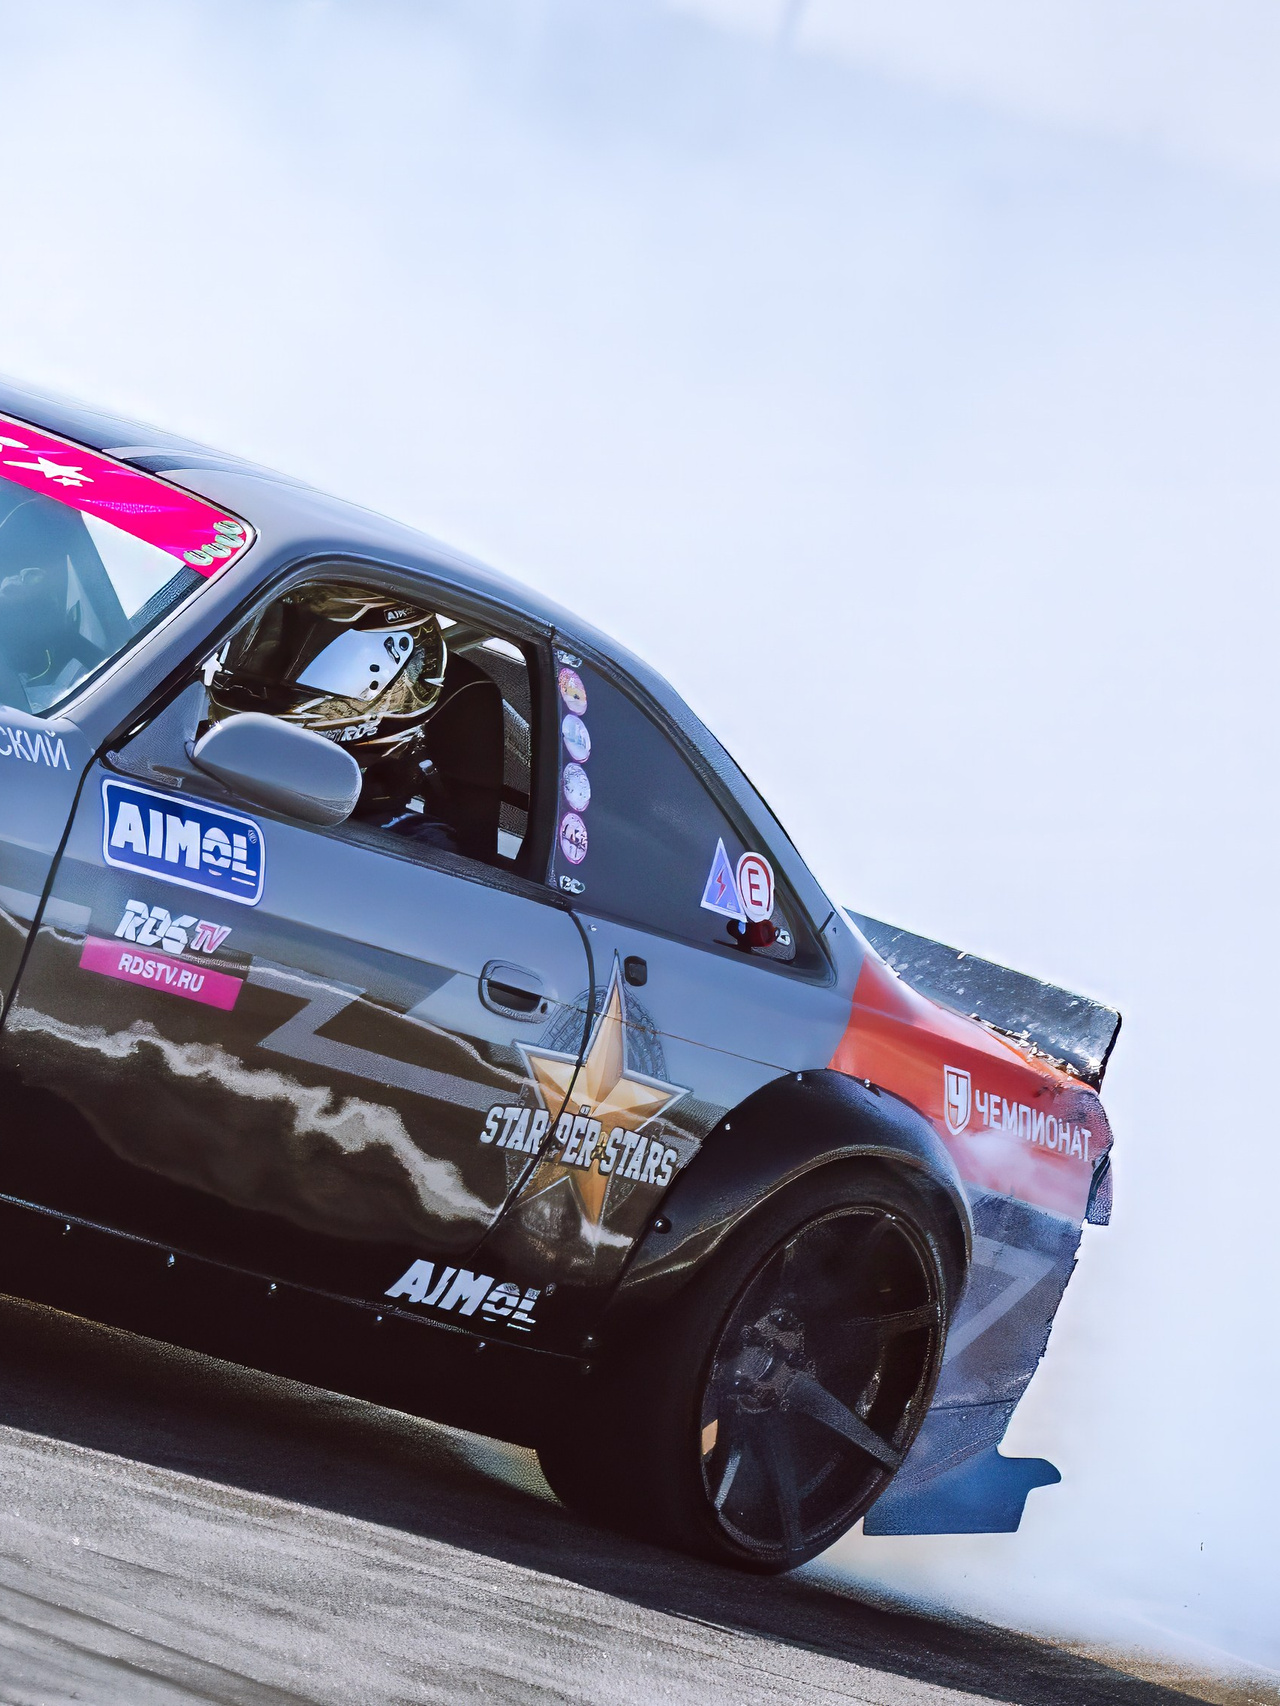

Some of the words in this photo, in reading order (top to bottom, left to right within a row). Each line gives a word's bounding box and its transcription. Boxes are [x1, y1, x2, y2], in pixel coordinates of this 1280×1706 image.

[110, 801, 257, 887] AIMOL
[117, 953, 205, 993] RDSTV.RU
[600, 1127, 678, 1187] STARS
[975, 1089, 1092, 1162] ЧЕМПИОНАТ
